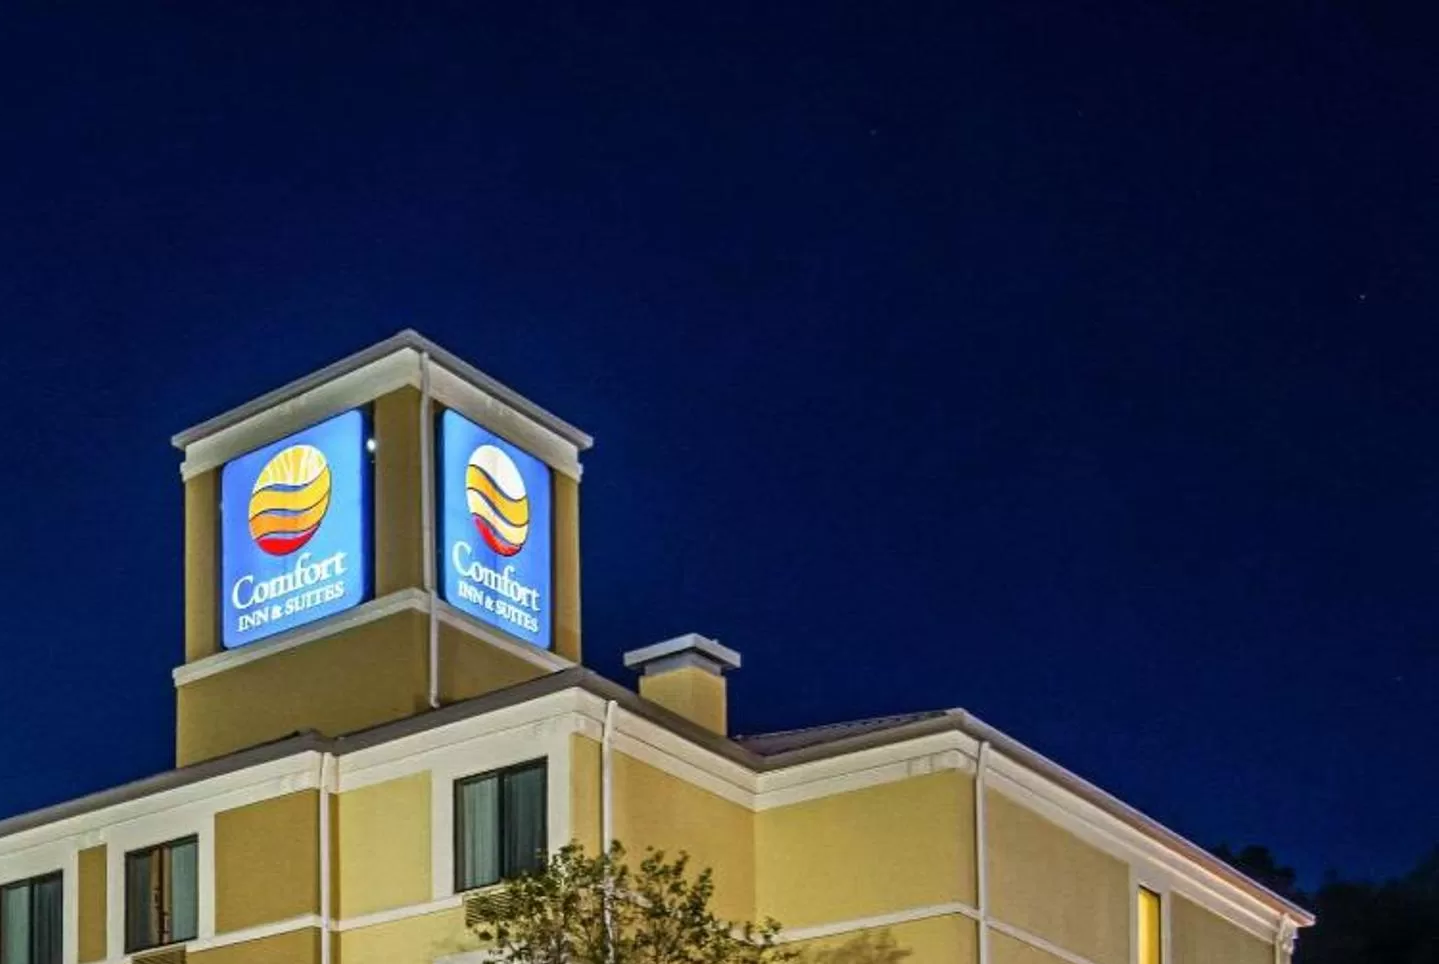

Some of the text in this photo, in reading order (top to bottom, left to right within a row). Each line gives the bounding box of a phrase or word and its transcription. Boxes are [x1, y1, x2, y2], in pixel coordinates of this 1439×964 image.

[232, 551, 348, 610] Comfort
[452, 540, 540, 612] Comfort
[237, 580, 345, 632] INN & SUITES
[458, 580, 484, 606] INN
[495, 600, 539, 633] SUITES
